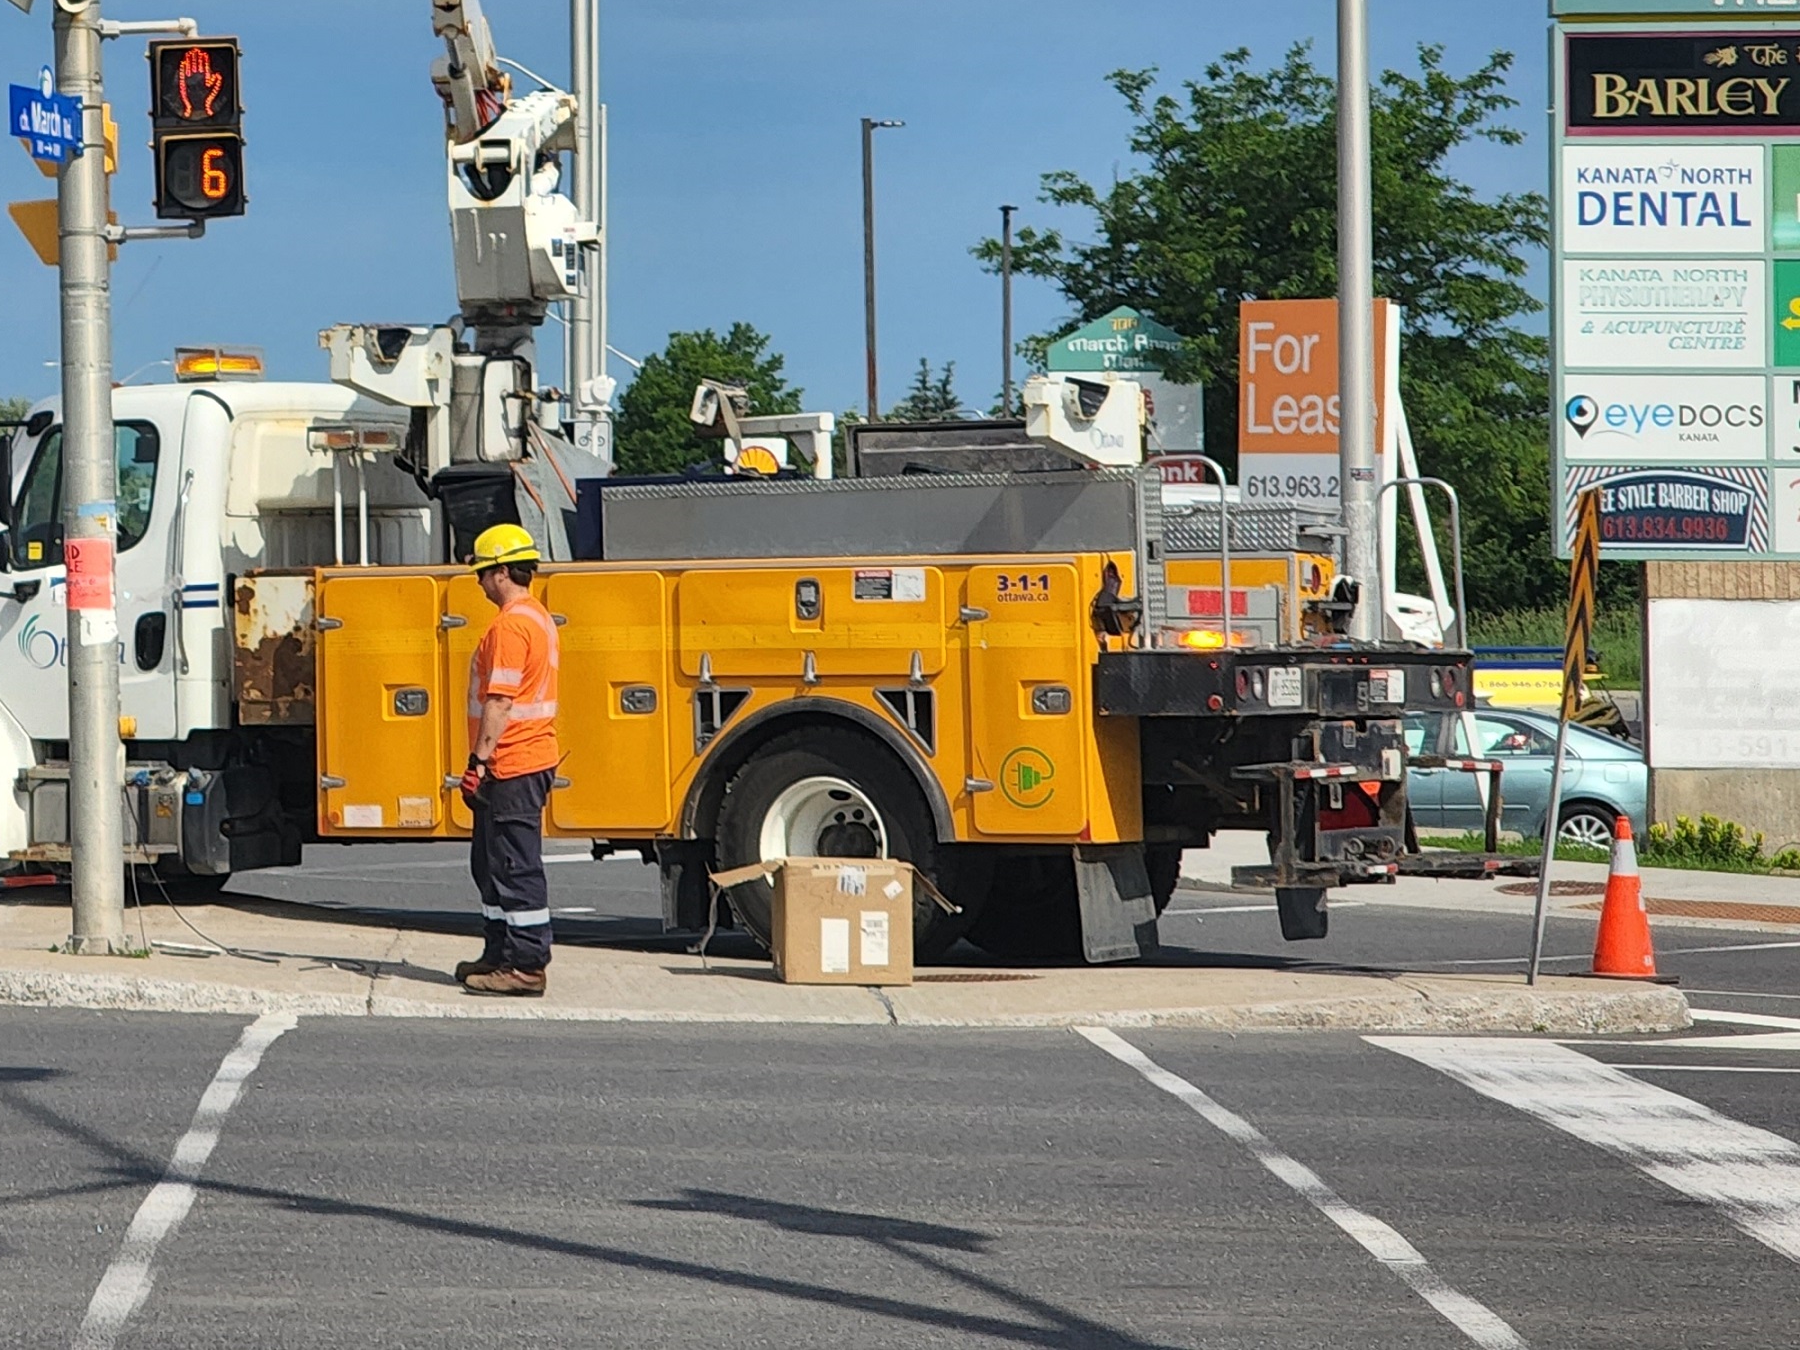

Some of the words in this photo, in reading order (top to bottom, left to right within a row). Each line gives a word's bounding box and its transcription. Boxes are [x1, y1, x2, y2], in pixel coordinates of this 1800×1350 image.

[1743, 42, 1788, 67] The
[1591, 73, 1790, 118] BARLEY
[31, 100, 62, 138] March
[203, 149, 227, 198] 6
[1577, 167, 1658, 185] KANATA
[1681, 167, 1752, 185] NORTH
[1577, 191, 1752, 227] DENTAL
[1579, 269, 1663, 282] KANATA
[1673, 269, 1748, 282] NORTH
[1580, 320, 1595, 334] &
[1602, 320, 1746, 334] ACUPUNCTURE
[1247, 322, 1320, 375] For
[1668, 336, 1746, 350] CENTRE
[1247, 382, 1378, 436] Leas
[1678, 433, 1719, 442] KANATA
[1248, 475, 1339, 498] 613.963.2
[1617, 482, 1656, 510] STYLE
[1658, 482, 1710, 513] BARBER
[1711, 488, 1748, 516] SHOP
[997, 575, 1049, 591] 3-1-1
[997, 593, 1049, 603] ottawa.ca
